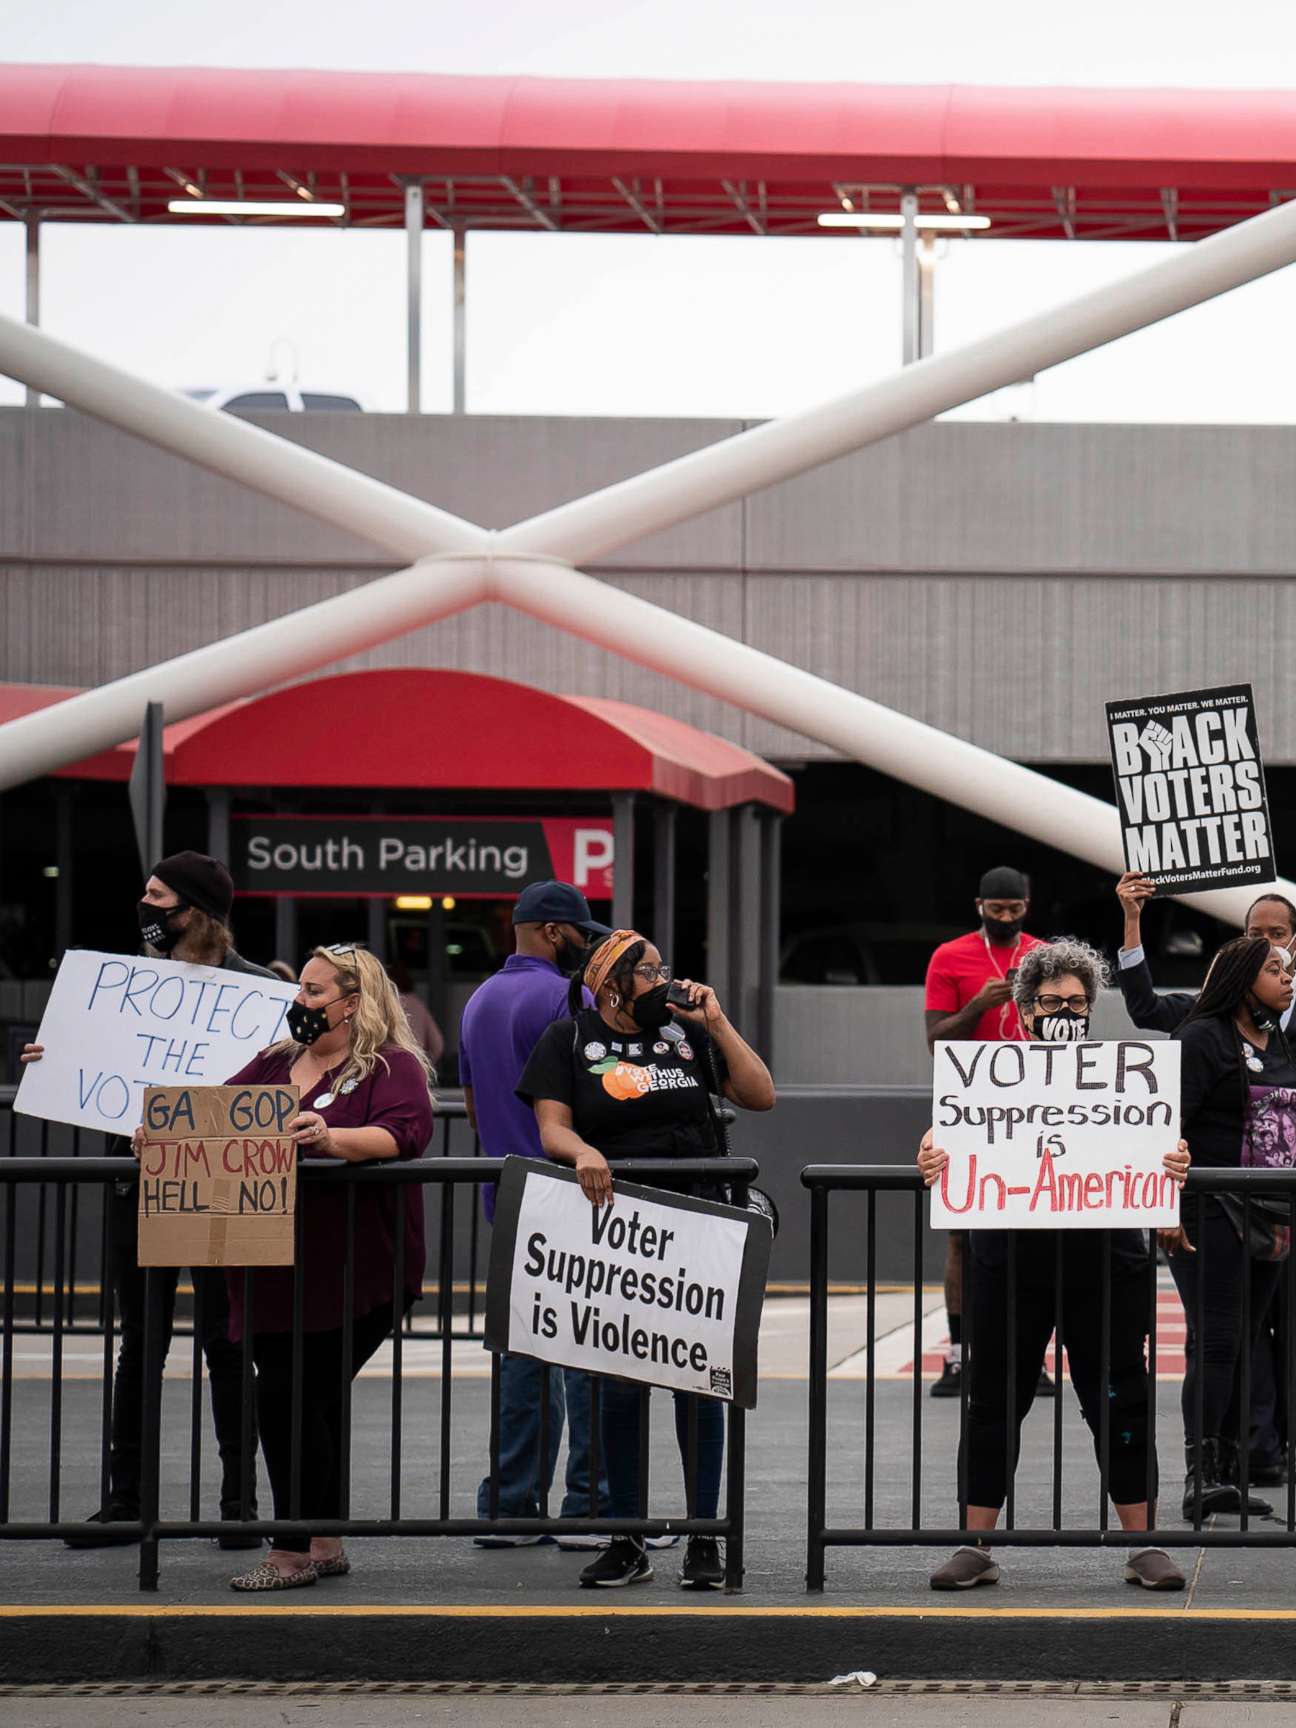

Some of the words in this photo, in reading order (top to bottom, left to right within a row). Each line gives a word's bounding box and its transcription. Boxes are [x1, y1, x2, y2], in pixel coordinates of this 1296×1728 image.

[1114, 708, 1147, 720] MATTER.
[1148, 705, 1166, 715] YOU
[1167, 702, 1200, 713] MATTER.
[1201, 699, 1214, 708] WE
[1215, 695, 1249, 706] MATTER.
[1118, 760, 1263, 825] VOTERS
[247, 836, 364, 871] South
[379, 837, 528, 879] Parking
[573, 828, 614, 886] P
[1125, 811, 1270, 873] MATTER
[88, 961, 293, 1044] PROTECT
[1042, 1017, 1086, 1041] VOTE
[137, 1034, 210, 1076] THE
[944, 1041, 1158, 1095] VOTER
[77, 1069, 161, 1121] VO
[637, 1076, 699, 1092] GEORGIA
[147, 1091, 195, 1131] GA
[230, 1090, 294, 1132] GOP
[939, 1095, 1172, 1144] Suppression
[143, 1138, 211, 1178] JIM
[222, 1138, 295, 1177] CROW
[1036, 1131, 1066, 1158] is
[144, 1177, 210, 1218] HELL
[239, 1177, 288, 1214] NO!
[940, 1148, 1177, 1215] Un-American
[592, 1204, 674, 1260] Voter
[524, 1232, 725, 1320] Suppression
[532, 1292, 558, 1338] is
[571, 1301, 708, 1372] Violence
